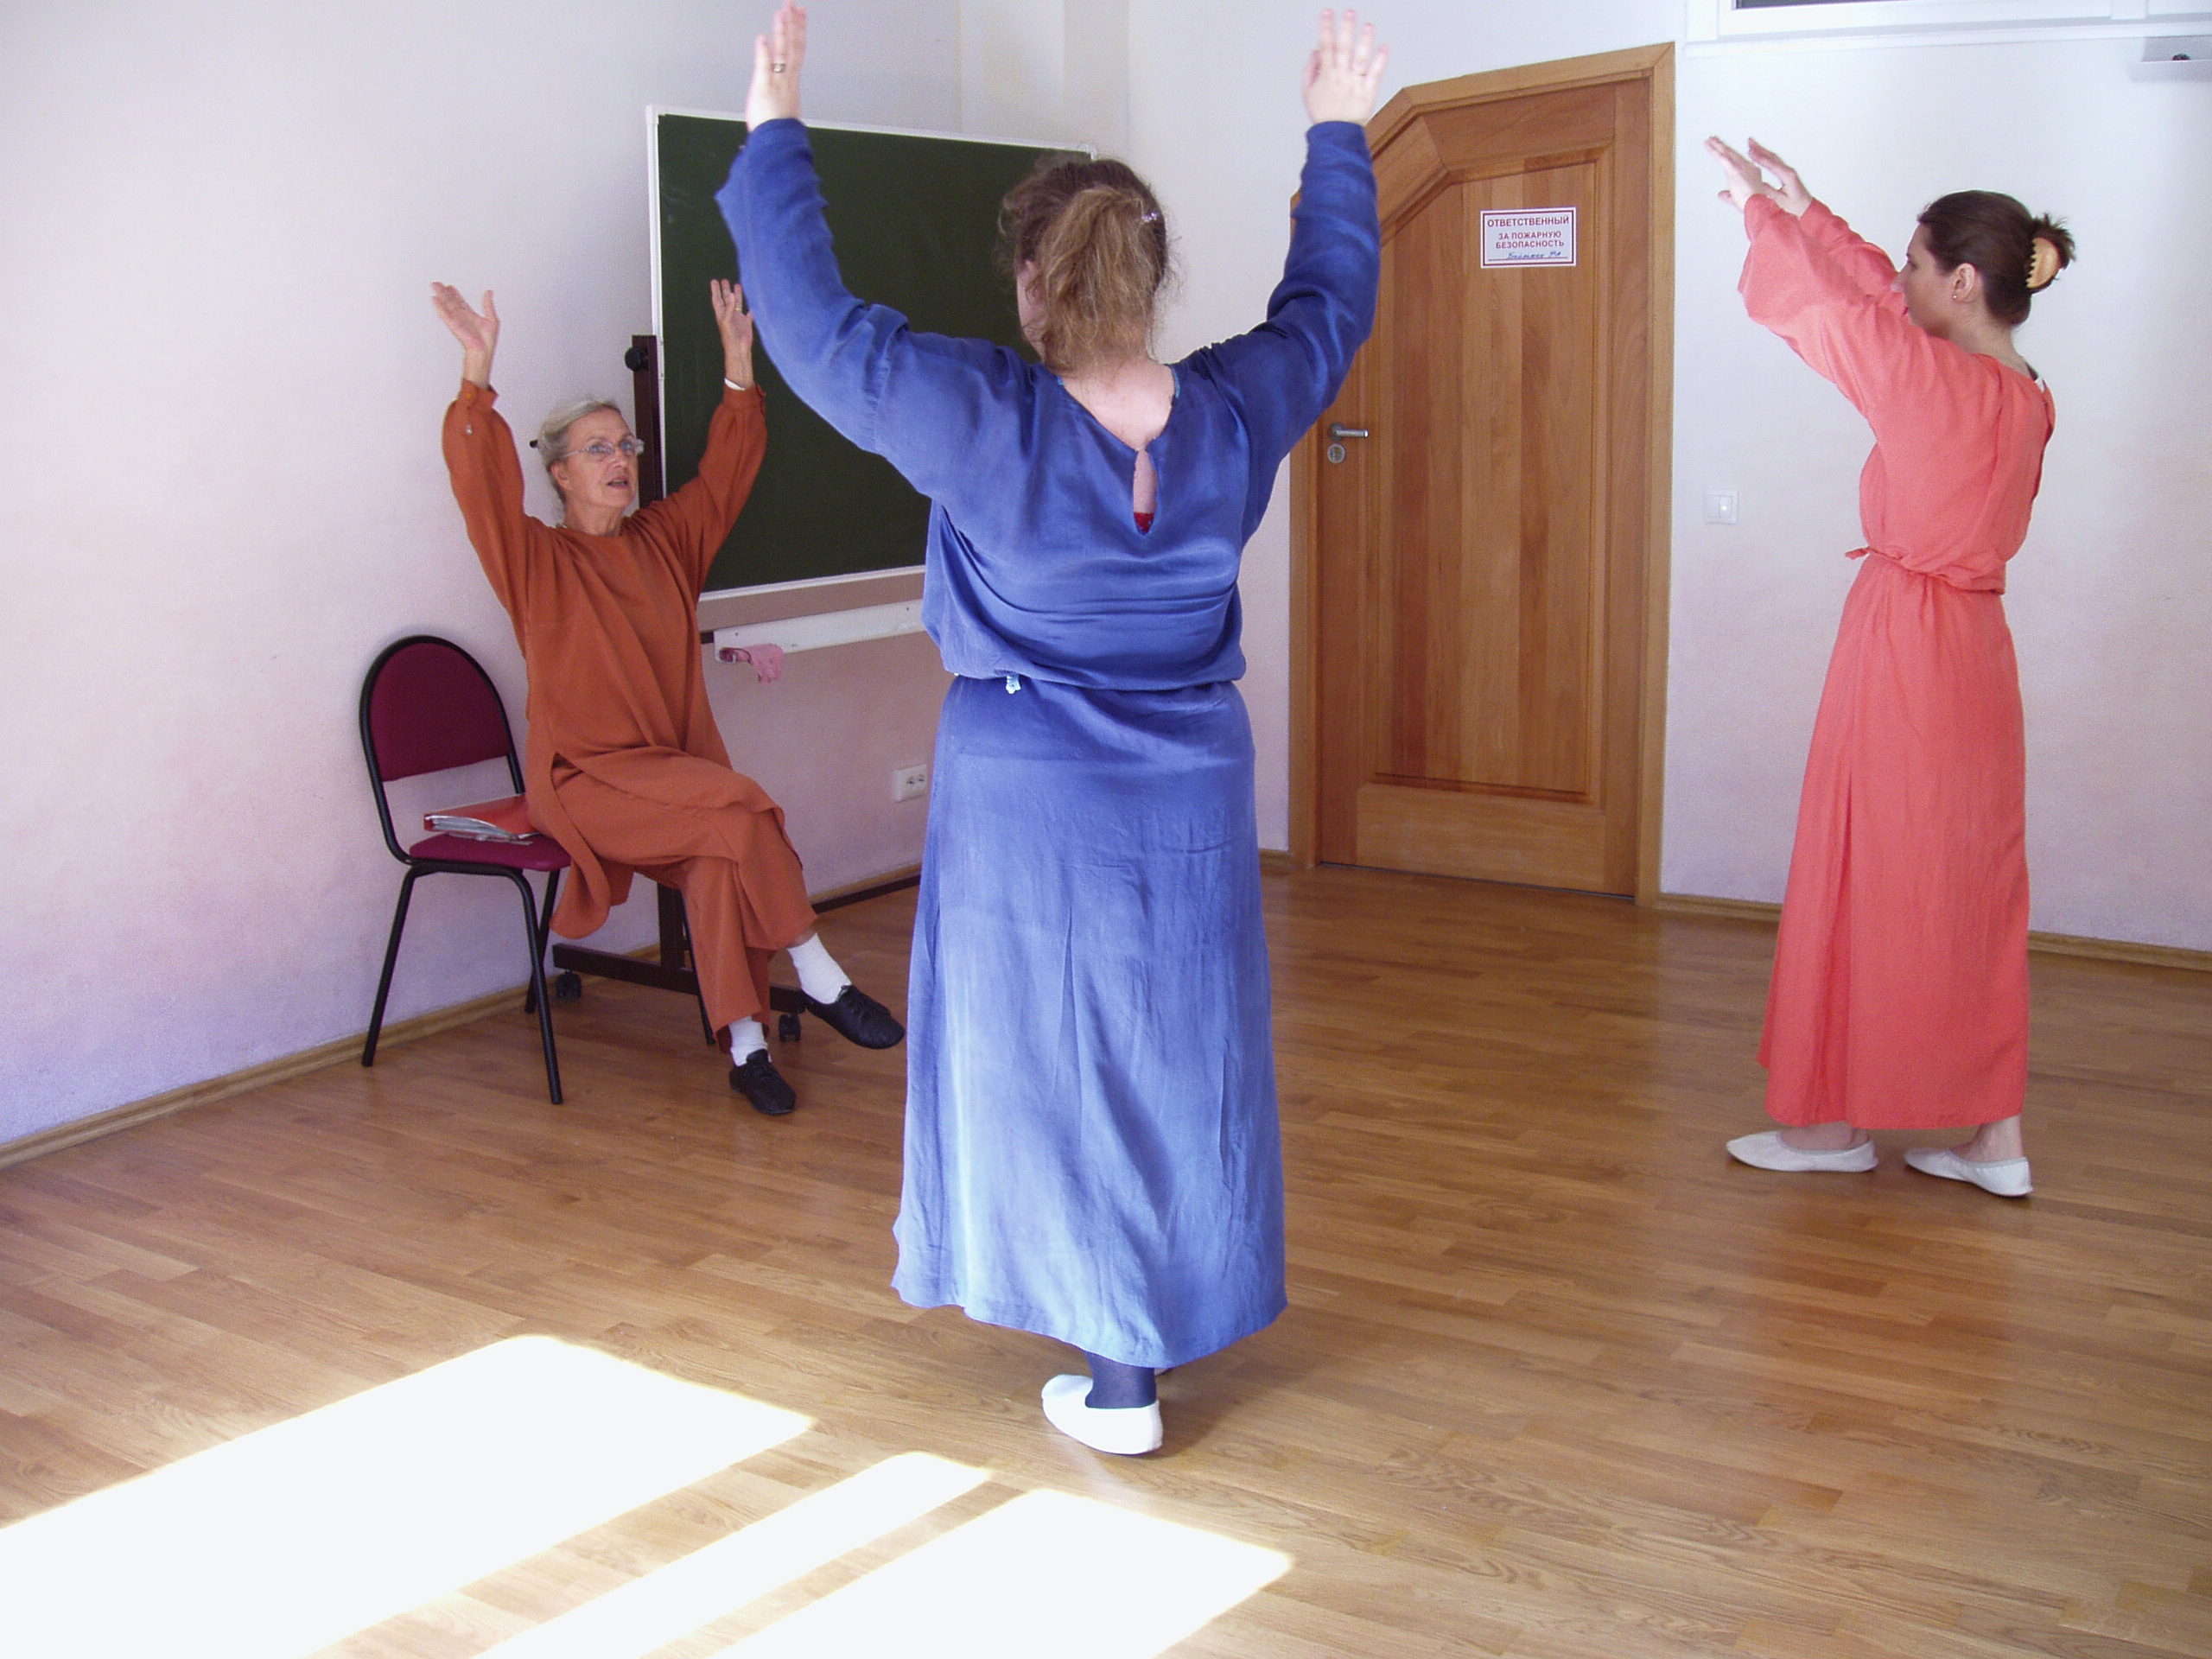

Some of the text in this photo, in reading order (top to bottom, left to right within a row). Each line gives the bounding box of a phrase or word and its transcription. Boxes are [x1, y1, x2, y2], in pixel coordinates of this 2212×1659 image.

[1487, 216, 1569, 227] ОТВЕТСТВЕННЫЙ
[1511, 231, 1561, 239] ПОЖАРНУЮ
[1496, 240, 1565, 249] БЕЗОПАСНОСТЬ
